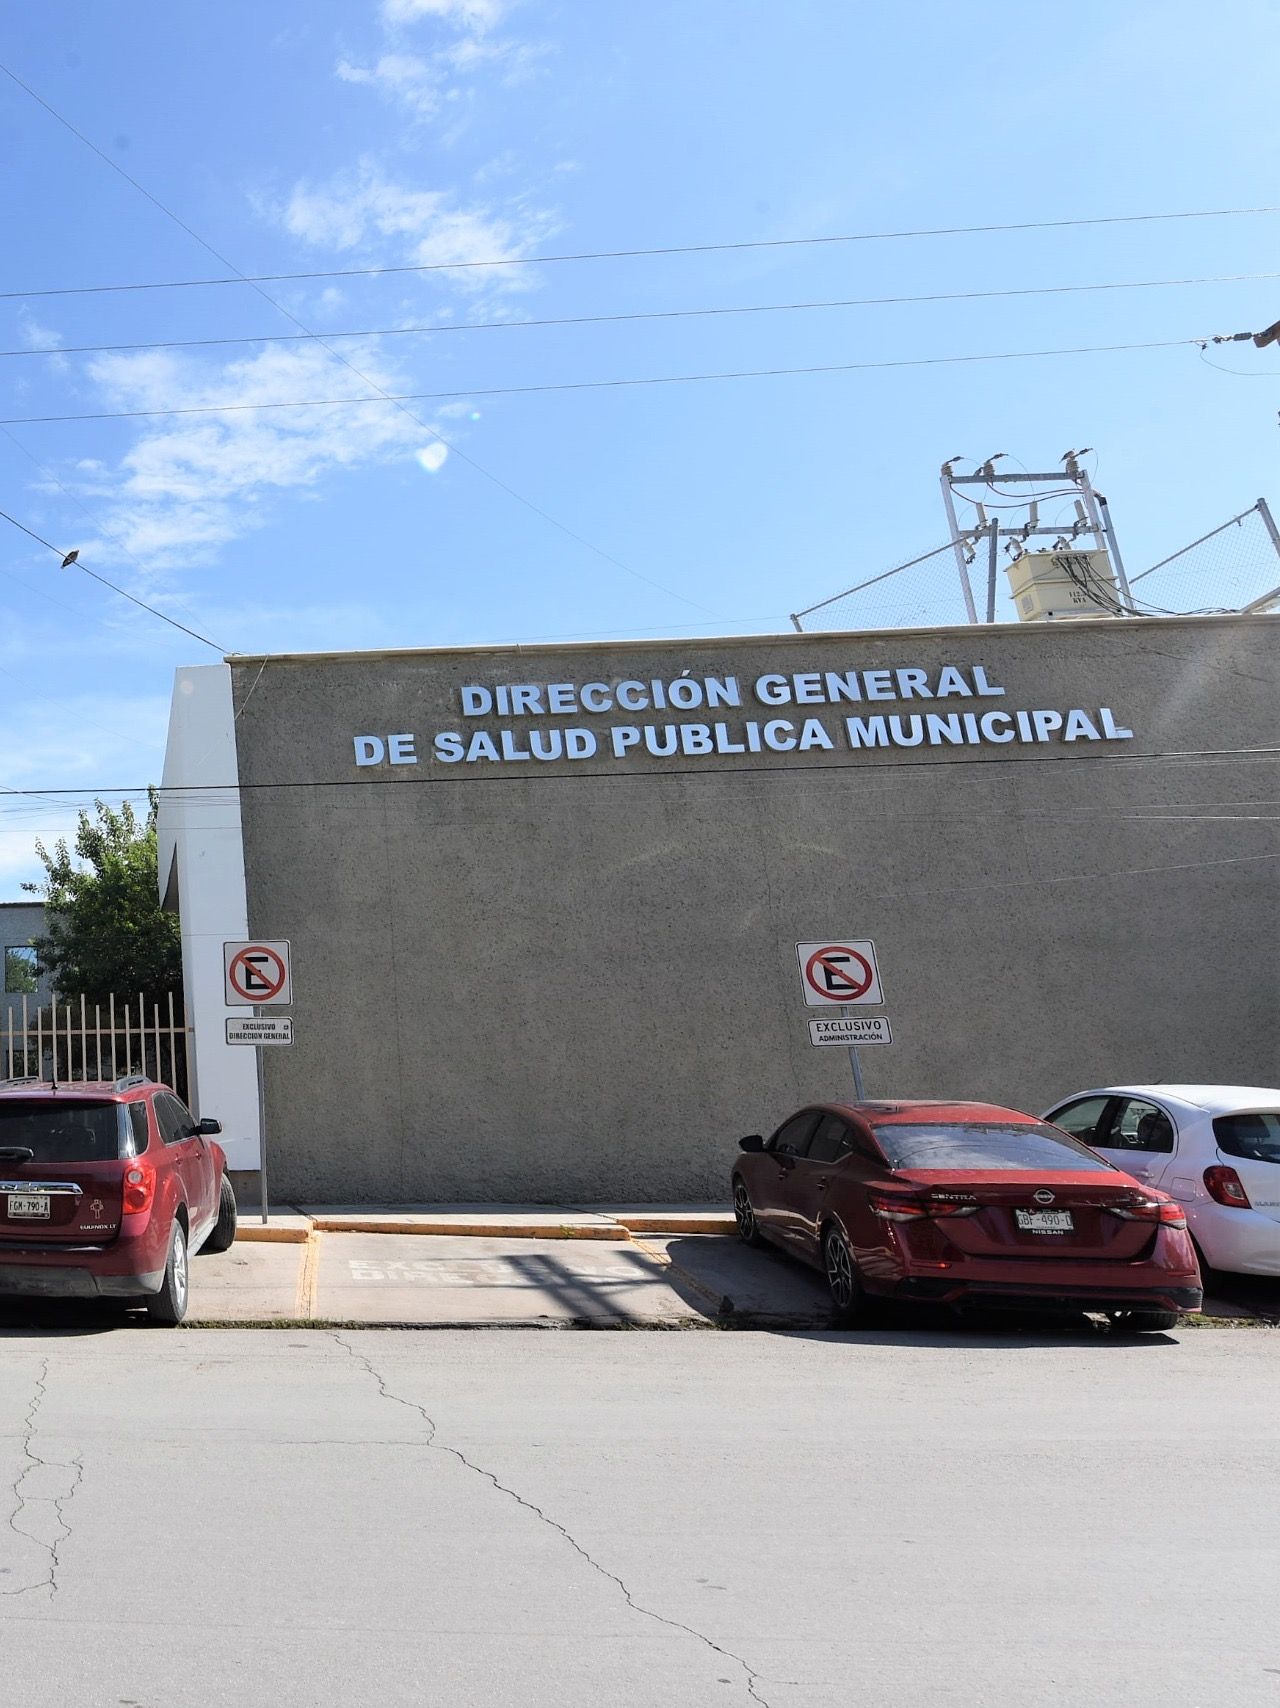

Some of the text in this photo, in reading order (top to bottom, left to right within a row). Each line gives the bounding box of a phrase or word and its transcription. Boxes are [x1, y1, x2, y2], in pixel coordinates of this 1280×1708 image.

[461, 665, 1007, 717] DIRECCIÓN GENERAL
[353, 707, 1135, 767] DE SALUD PUBLICA MUNICIPAL
[242, 1023, 276, 1031] EXCLUSIVO
[816, 1020, 882, 1033] EXCLUSIVO
[263, 1032, 290, 1040] GENERAL
[818, 1032, 883, 1042] ADMINISTRACIÓN
